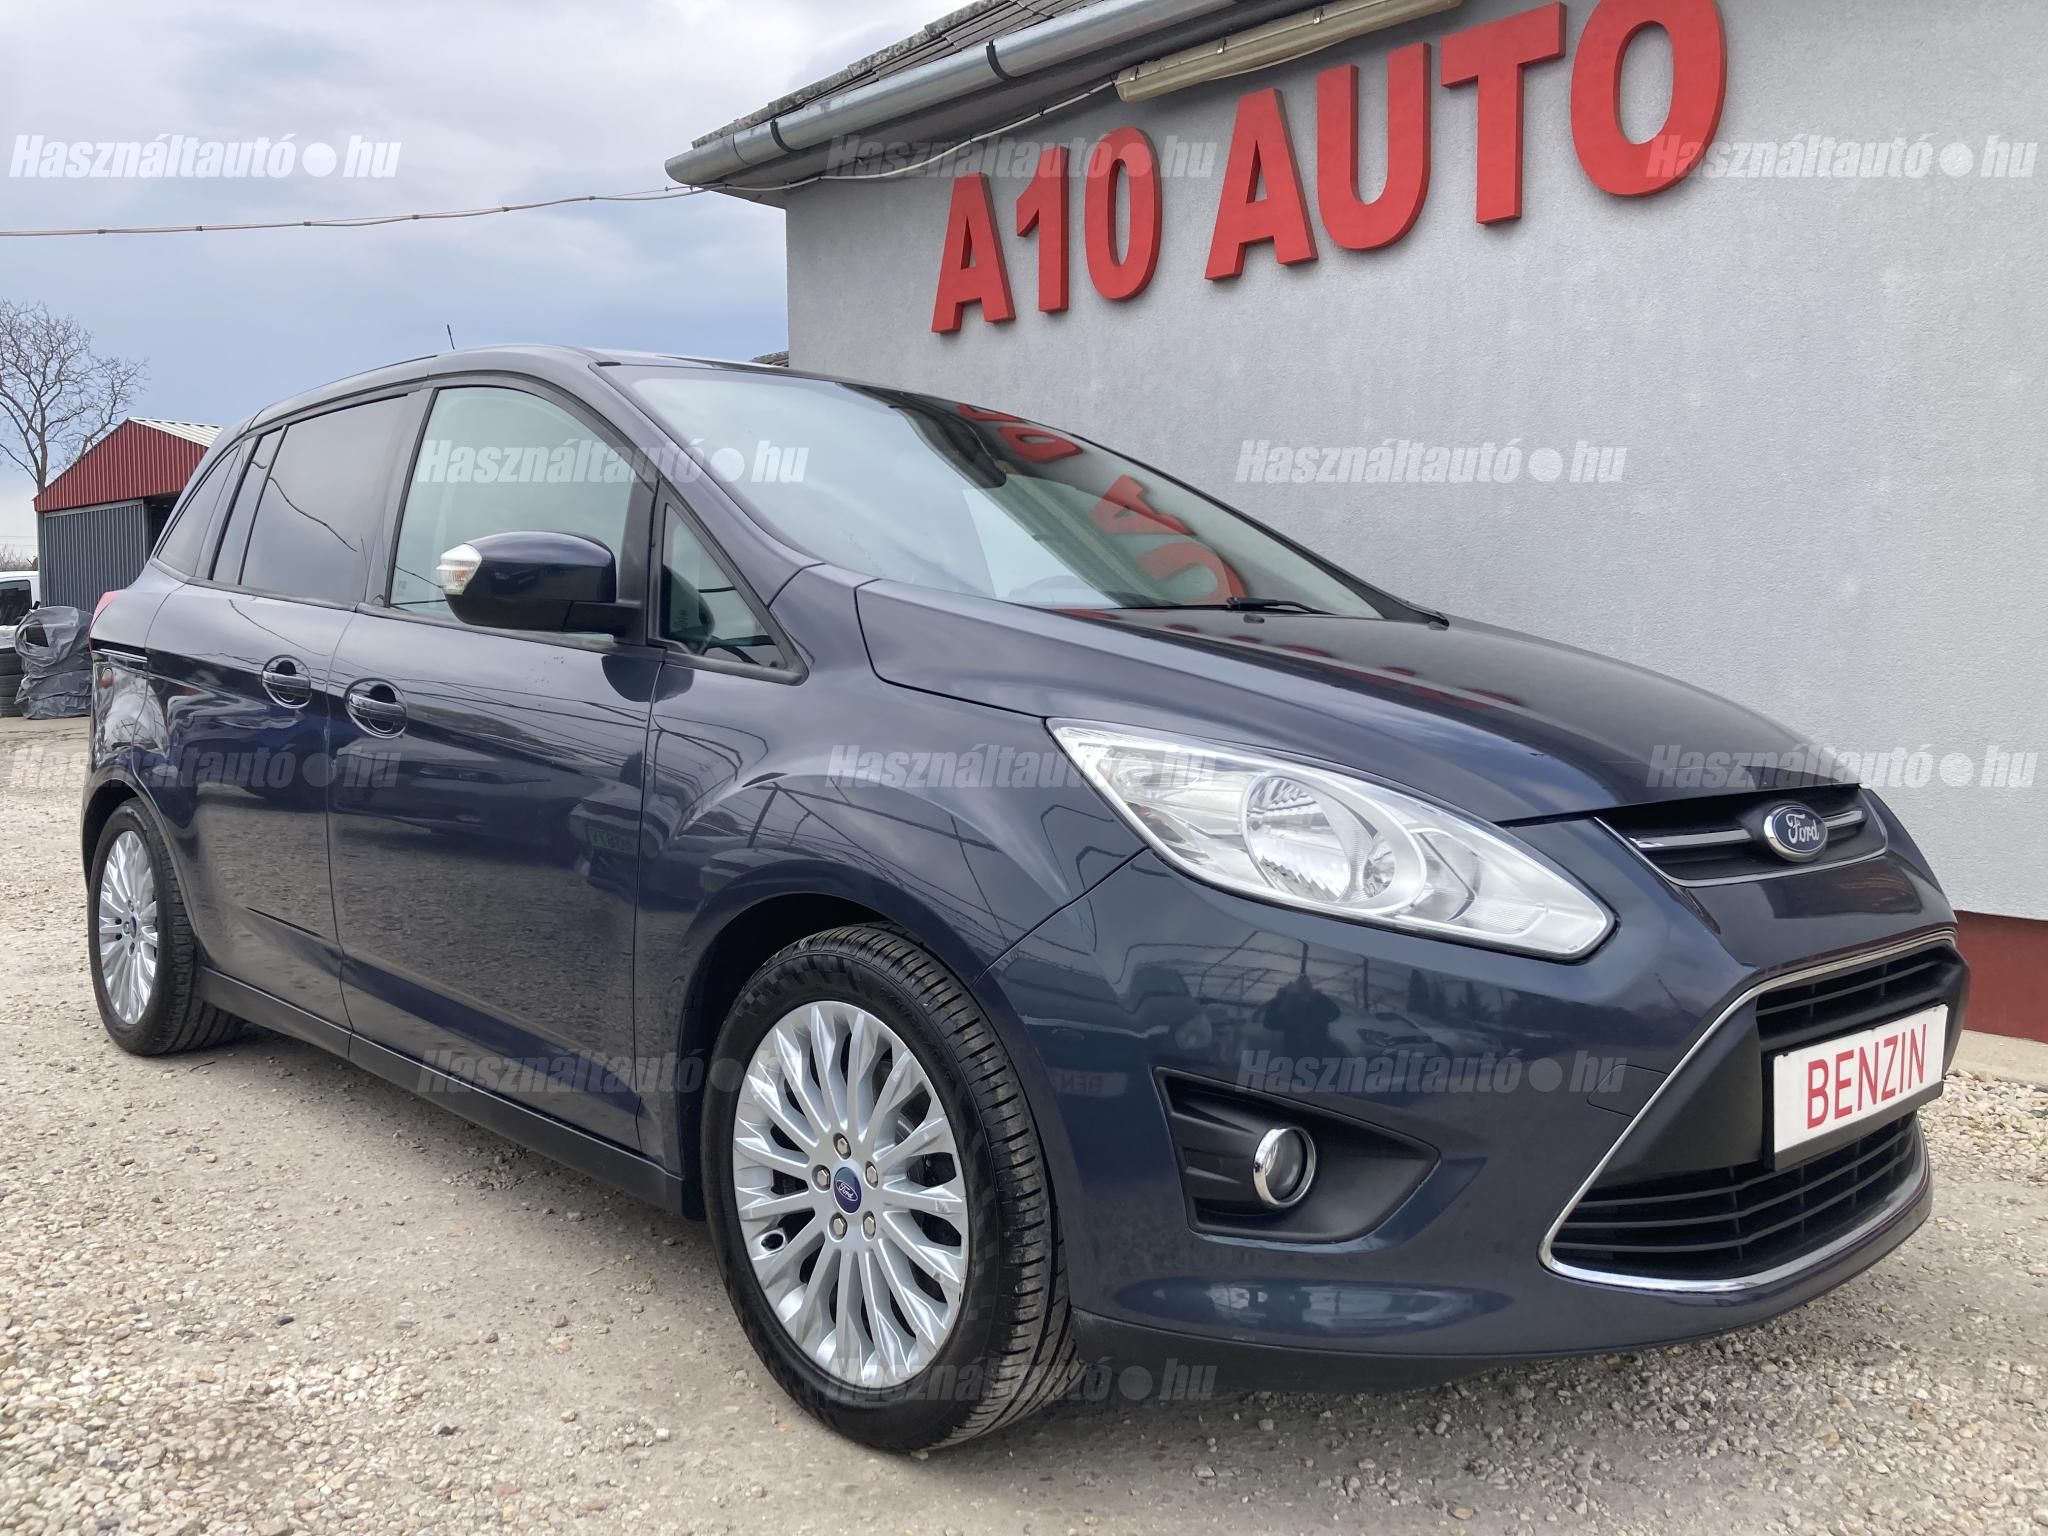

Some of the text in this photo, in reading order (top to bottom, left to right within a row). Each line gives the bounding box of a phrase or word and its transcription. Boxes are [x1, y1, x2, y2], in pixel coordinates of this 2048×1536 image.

[931, 0, 1728, 334] A10 AUTO
[1785, 813, 1820, 844] Ford
[1807, 1023, 1927, 1129] BENZIN
